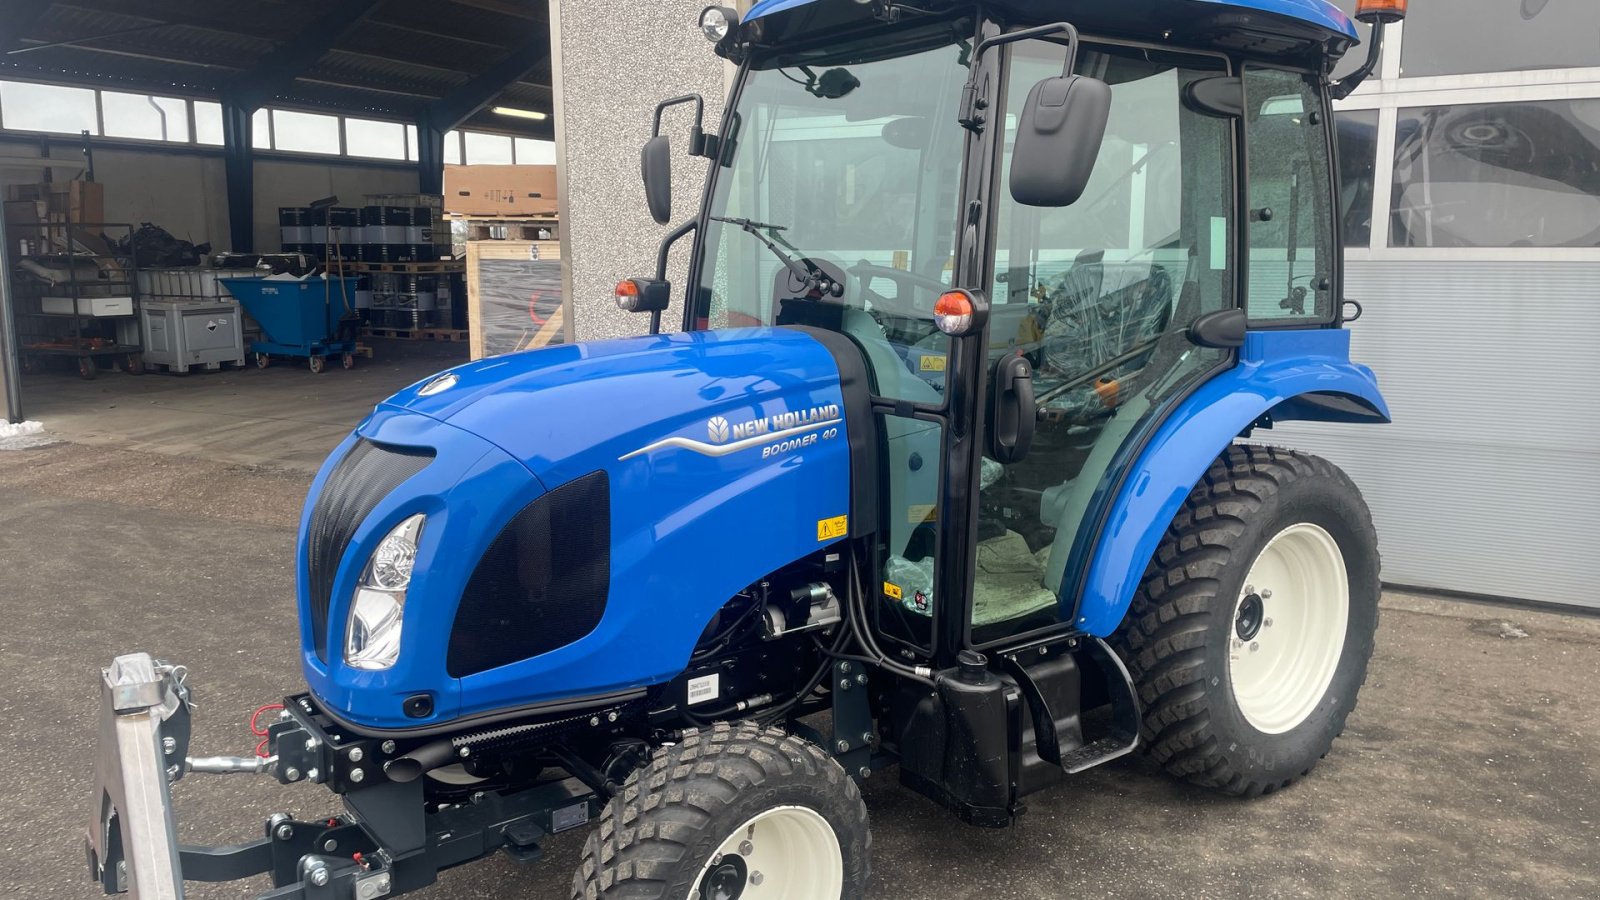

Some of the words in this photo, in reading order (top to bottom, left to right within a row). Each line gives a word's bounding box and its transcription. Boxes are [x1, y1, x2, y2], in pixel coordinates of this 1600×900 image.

[734, 417, 770, 439] NEW
[773, 405, 839, 430] HOLLAND
[763, 434, 818, 458] BOOMER
[822, 428, 838, 440] 40
